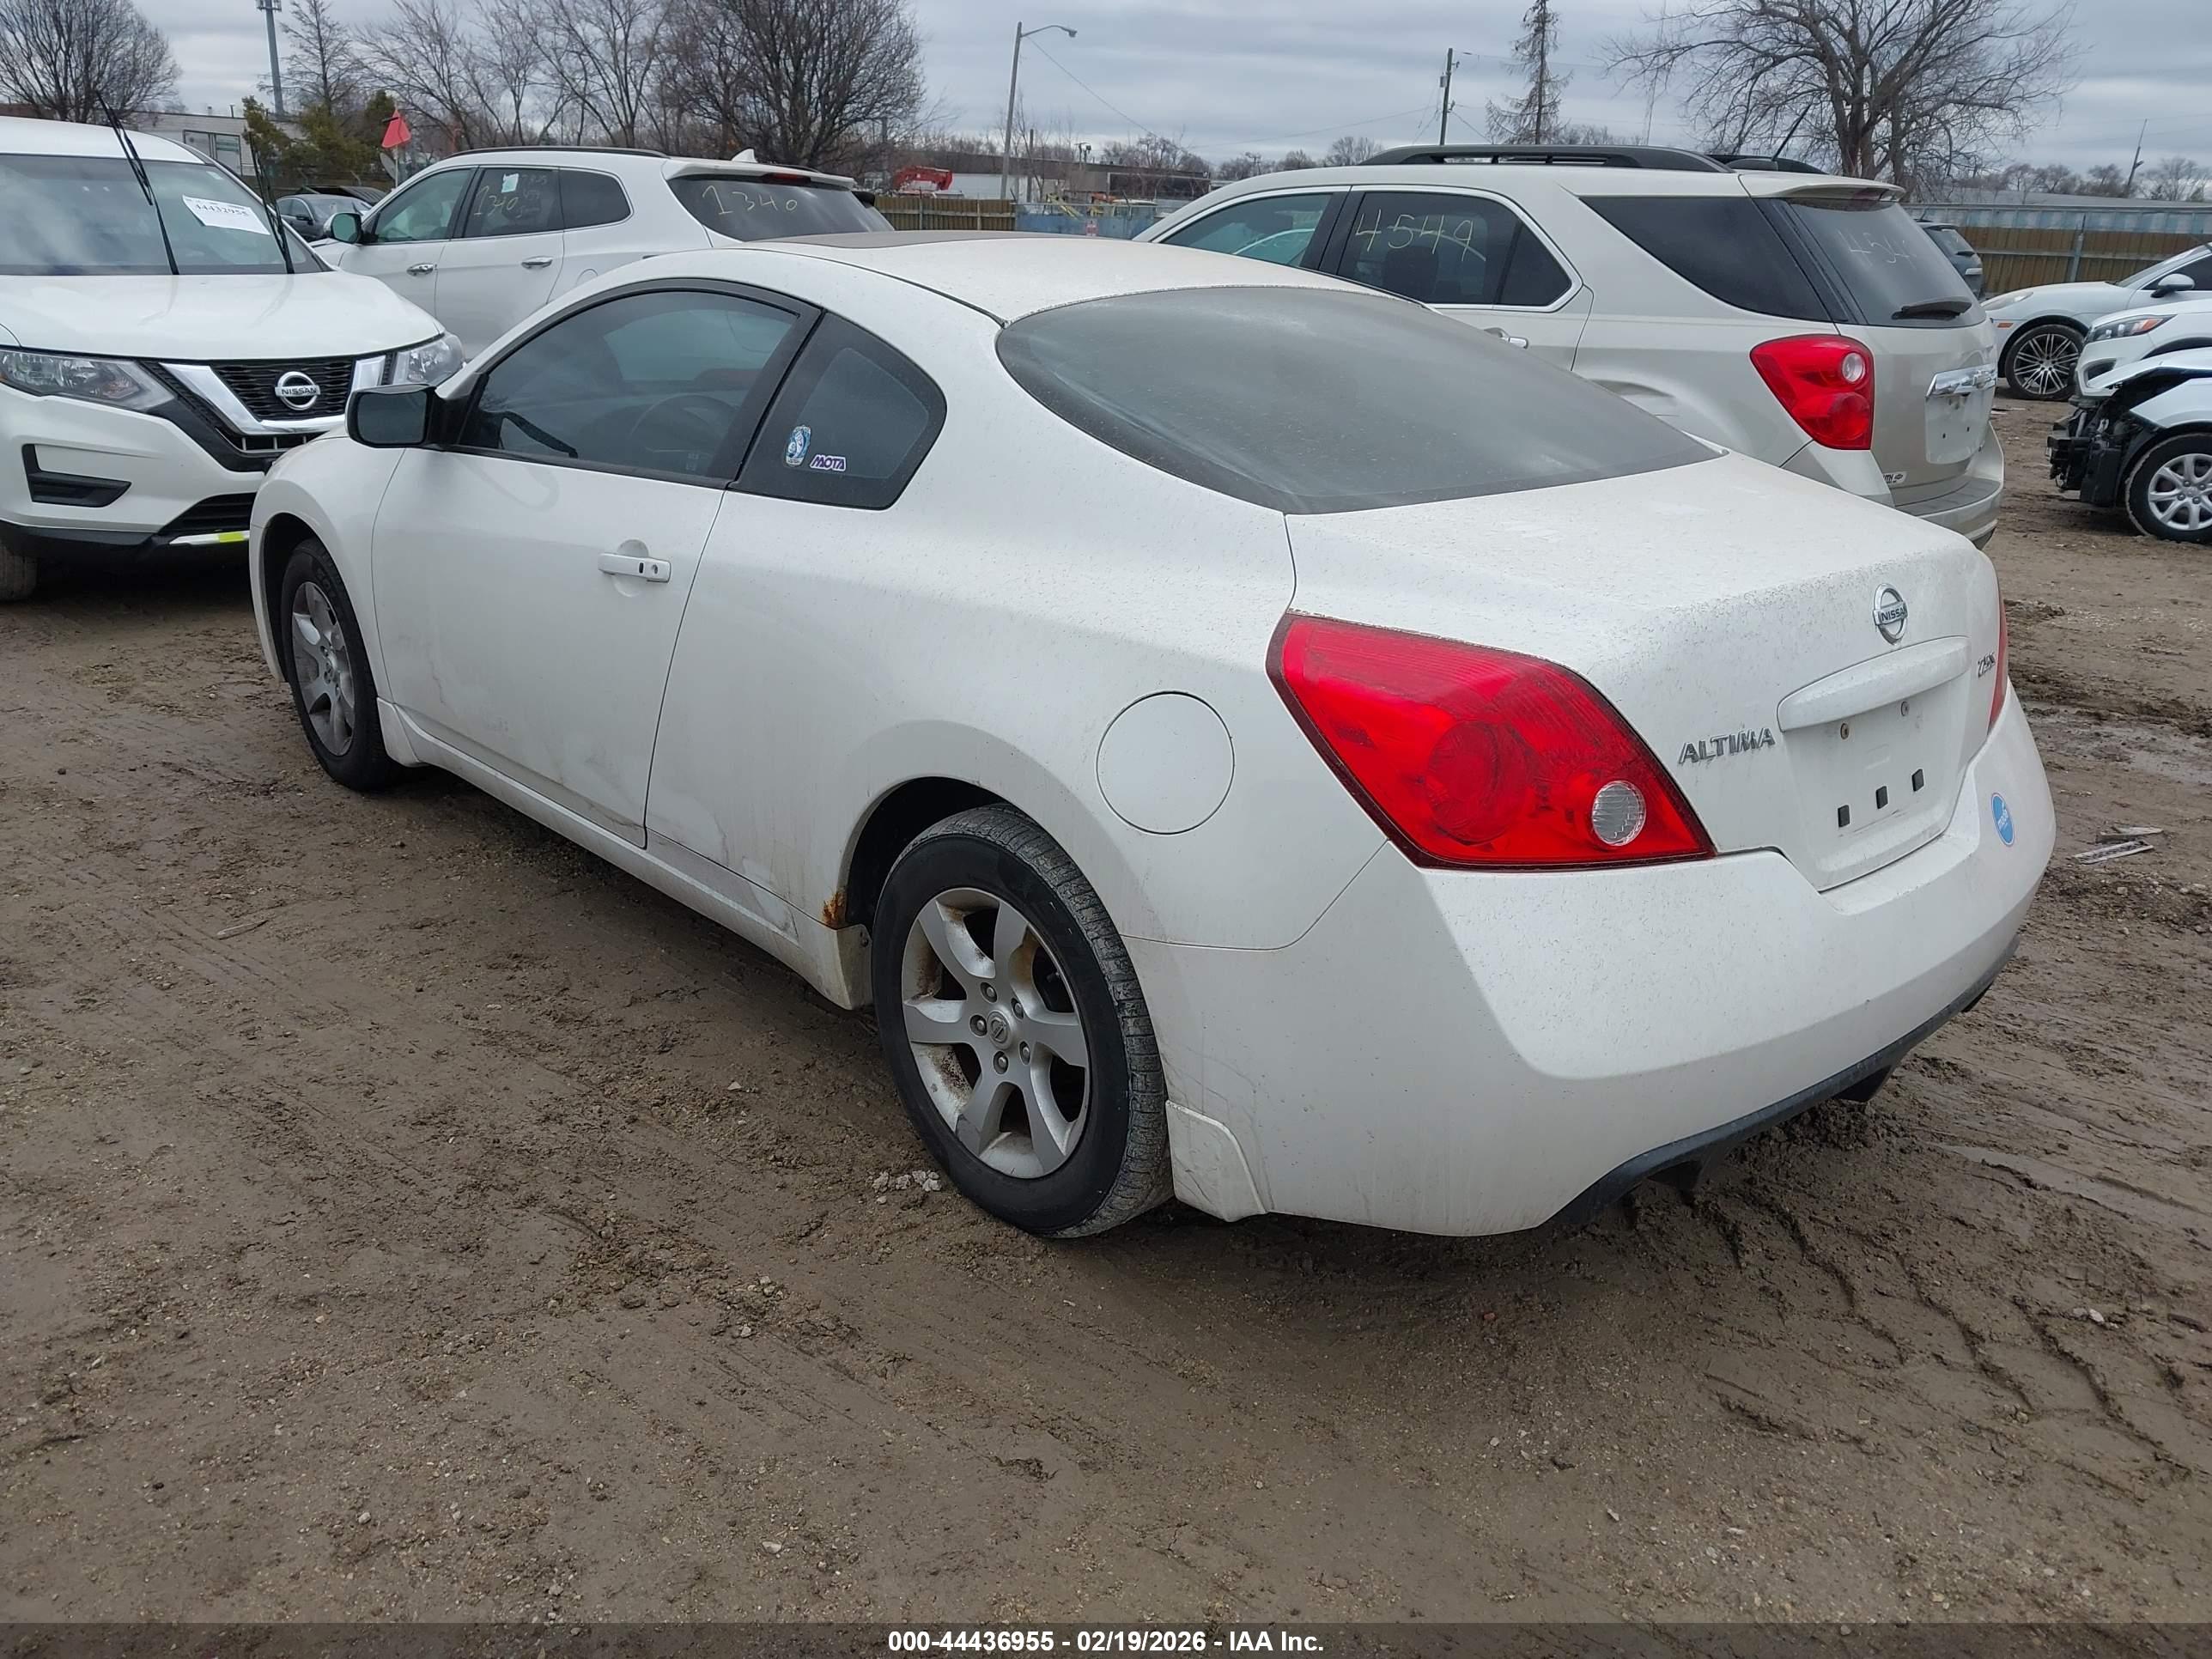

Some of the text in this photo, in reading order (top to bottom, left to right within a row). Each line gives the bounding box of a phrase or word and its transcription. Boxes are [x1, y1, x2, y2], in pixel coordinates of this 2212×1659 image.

[702, 185, 798, 215] 1340
[1355, 209, 1474, 262] 4549
[281, 386, 317, 395] NISSAN
[811, 454, 846, 471] MOTA
[1678, 727, 1776, 764] ALTIMA
